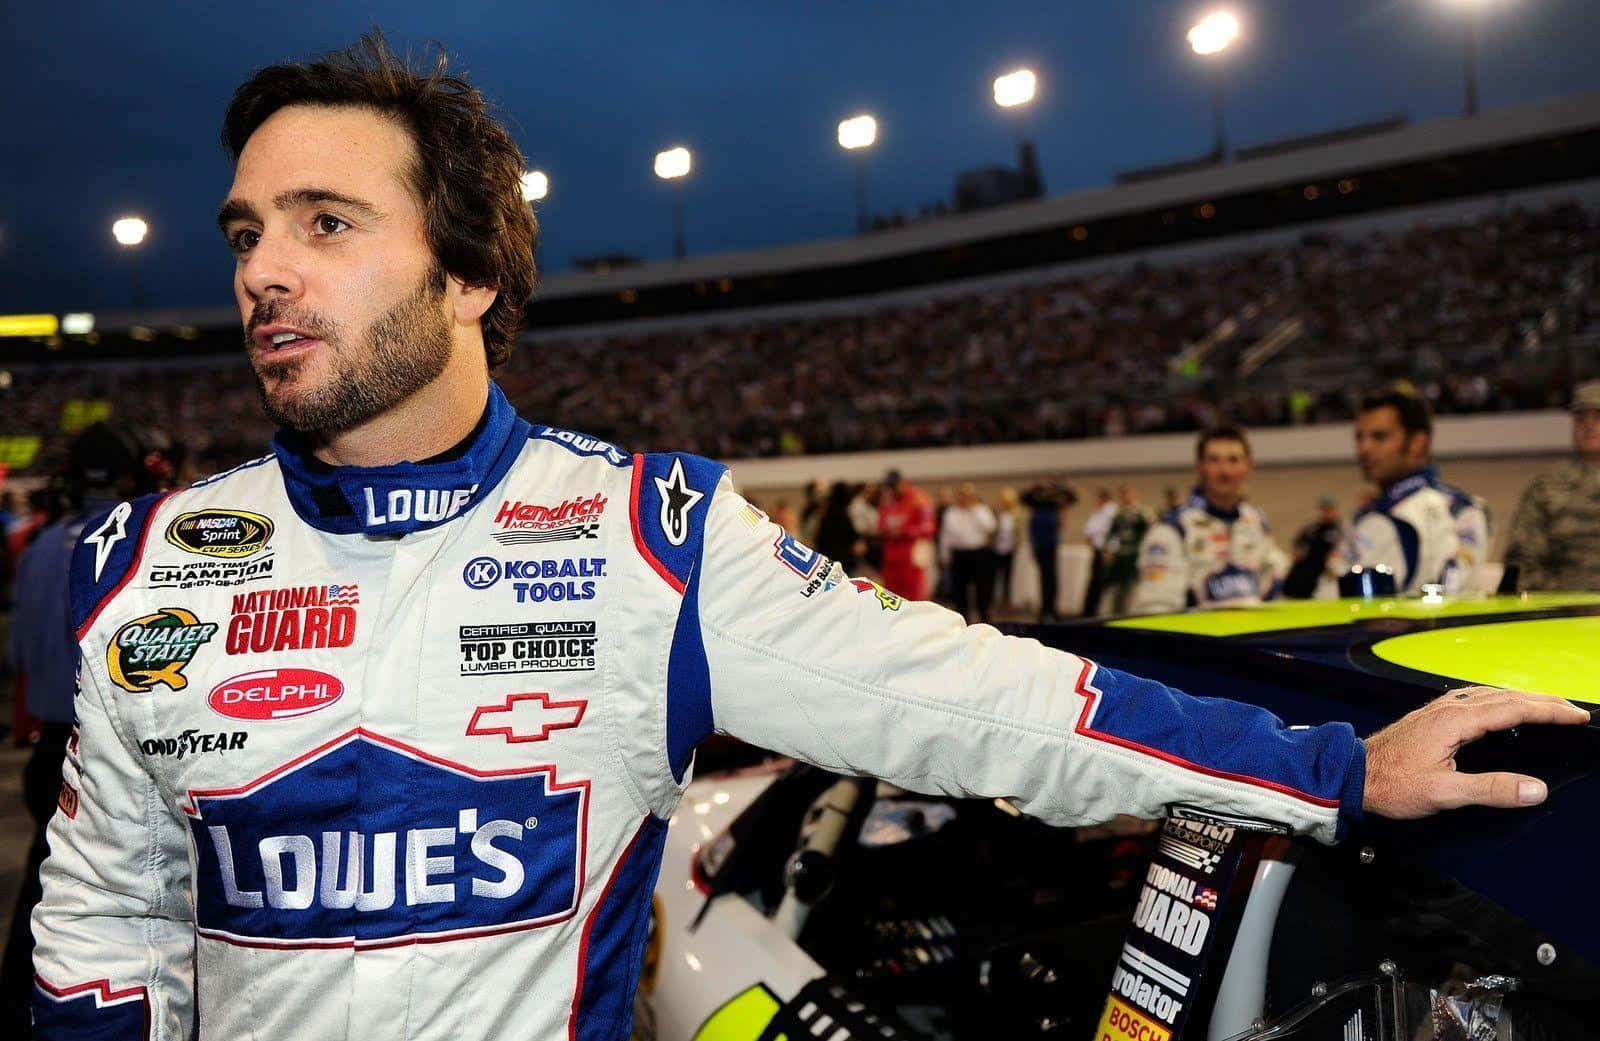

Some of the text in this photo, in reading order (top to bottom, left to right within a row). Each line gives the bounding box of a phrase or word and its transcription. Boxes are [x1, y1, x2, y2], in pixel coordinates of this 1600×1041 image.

[494, 492, 608, 529] Hendrick
[196, 517, 240, 530] NASCAR
[510, 514, 600, 530] MOTORSPORTS
[201, 529, 240, 543] Sprint
[202, 542, 262, 554] CUP SERIES
[150, 559, 274, 582] CHAMPION
[182, 560, 250, 571] FOUR-TIME
[504, 557, 606, 579] KOBALT
[513, 581, 596, 603] TOOLS
[800, 579, 822, 598] Let's
[231, 585, 329, 615] NATIONAL
[118, 624, 217, 648] QUAKER
[225, 606, 357, 656] GUARD
[462, 622, 593, 637] CERTIFIED QUALITY
[128, 642, 197, 665] STATE
[460, 638, 596, 662] TOP CHOICE
[460, 657, 595, 672] LUMBER PRODUCTS
[222, 683, 329, 704] DELPHI
[1146, 862, 1197, 904] TIONAL
[1133, 884, 1211, 957] UARD
